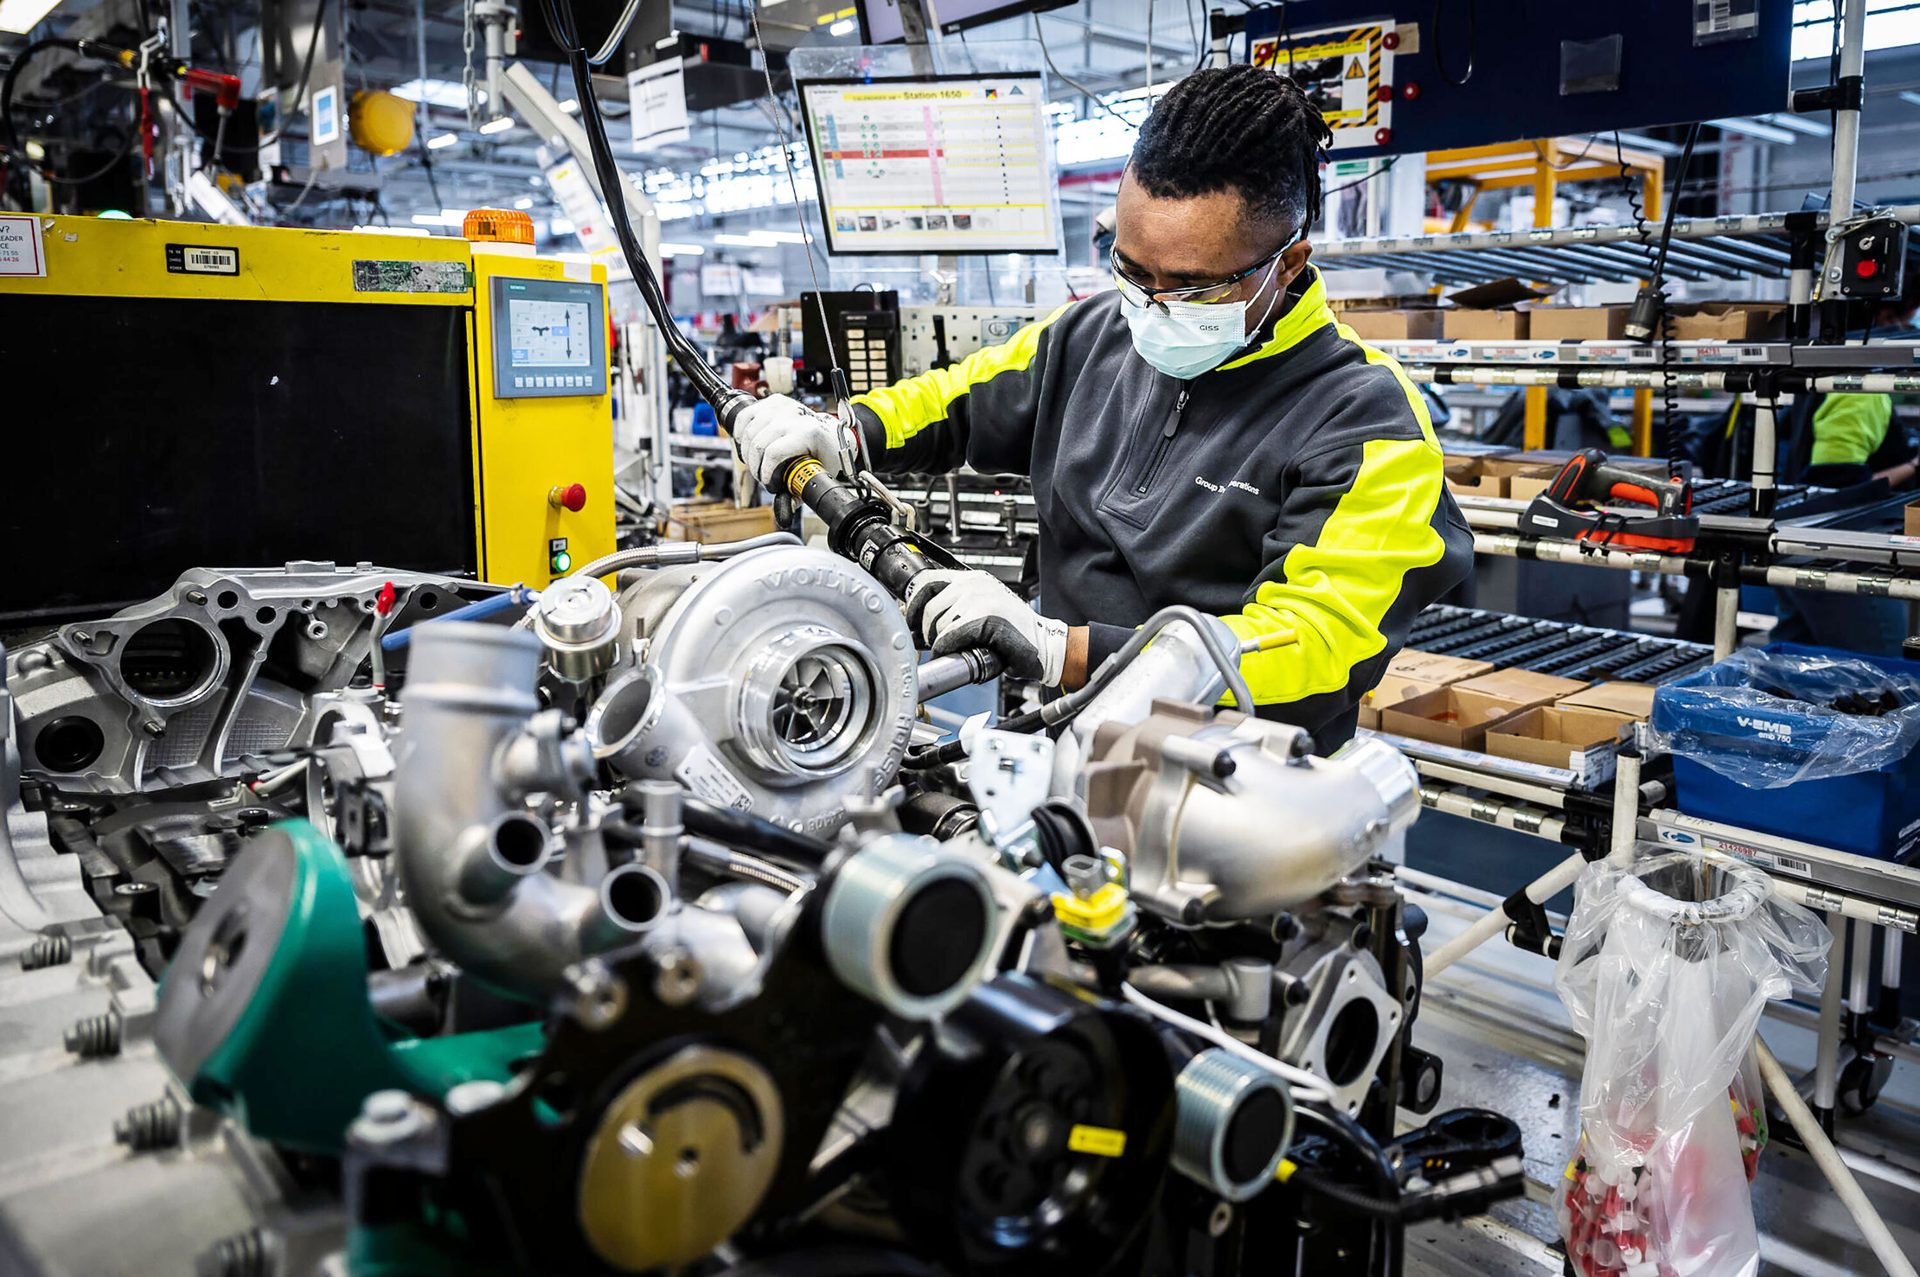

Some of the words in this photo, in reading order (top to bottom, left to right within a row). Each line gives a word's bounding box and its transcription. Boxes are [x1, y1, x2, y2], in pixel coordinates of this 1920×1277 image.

[903, 91, 937, 101] Station
[939, 90, 962, 100] 1650
[1194, 476, 1218, 492] Group
[757, 567, 885, 614] VOLVO
[1736, 715, 1792, 736] V-EMB
[1757, 732, 1776, 741] emb
[1776, 733, 1792, 744] 750
[873, 713, 912, 792] HOLSE
